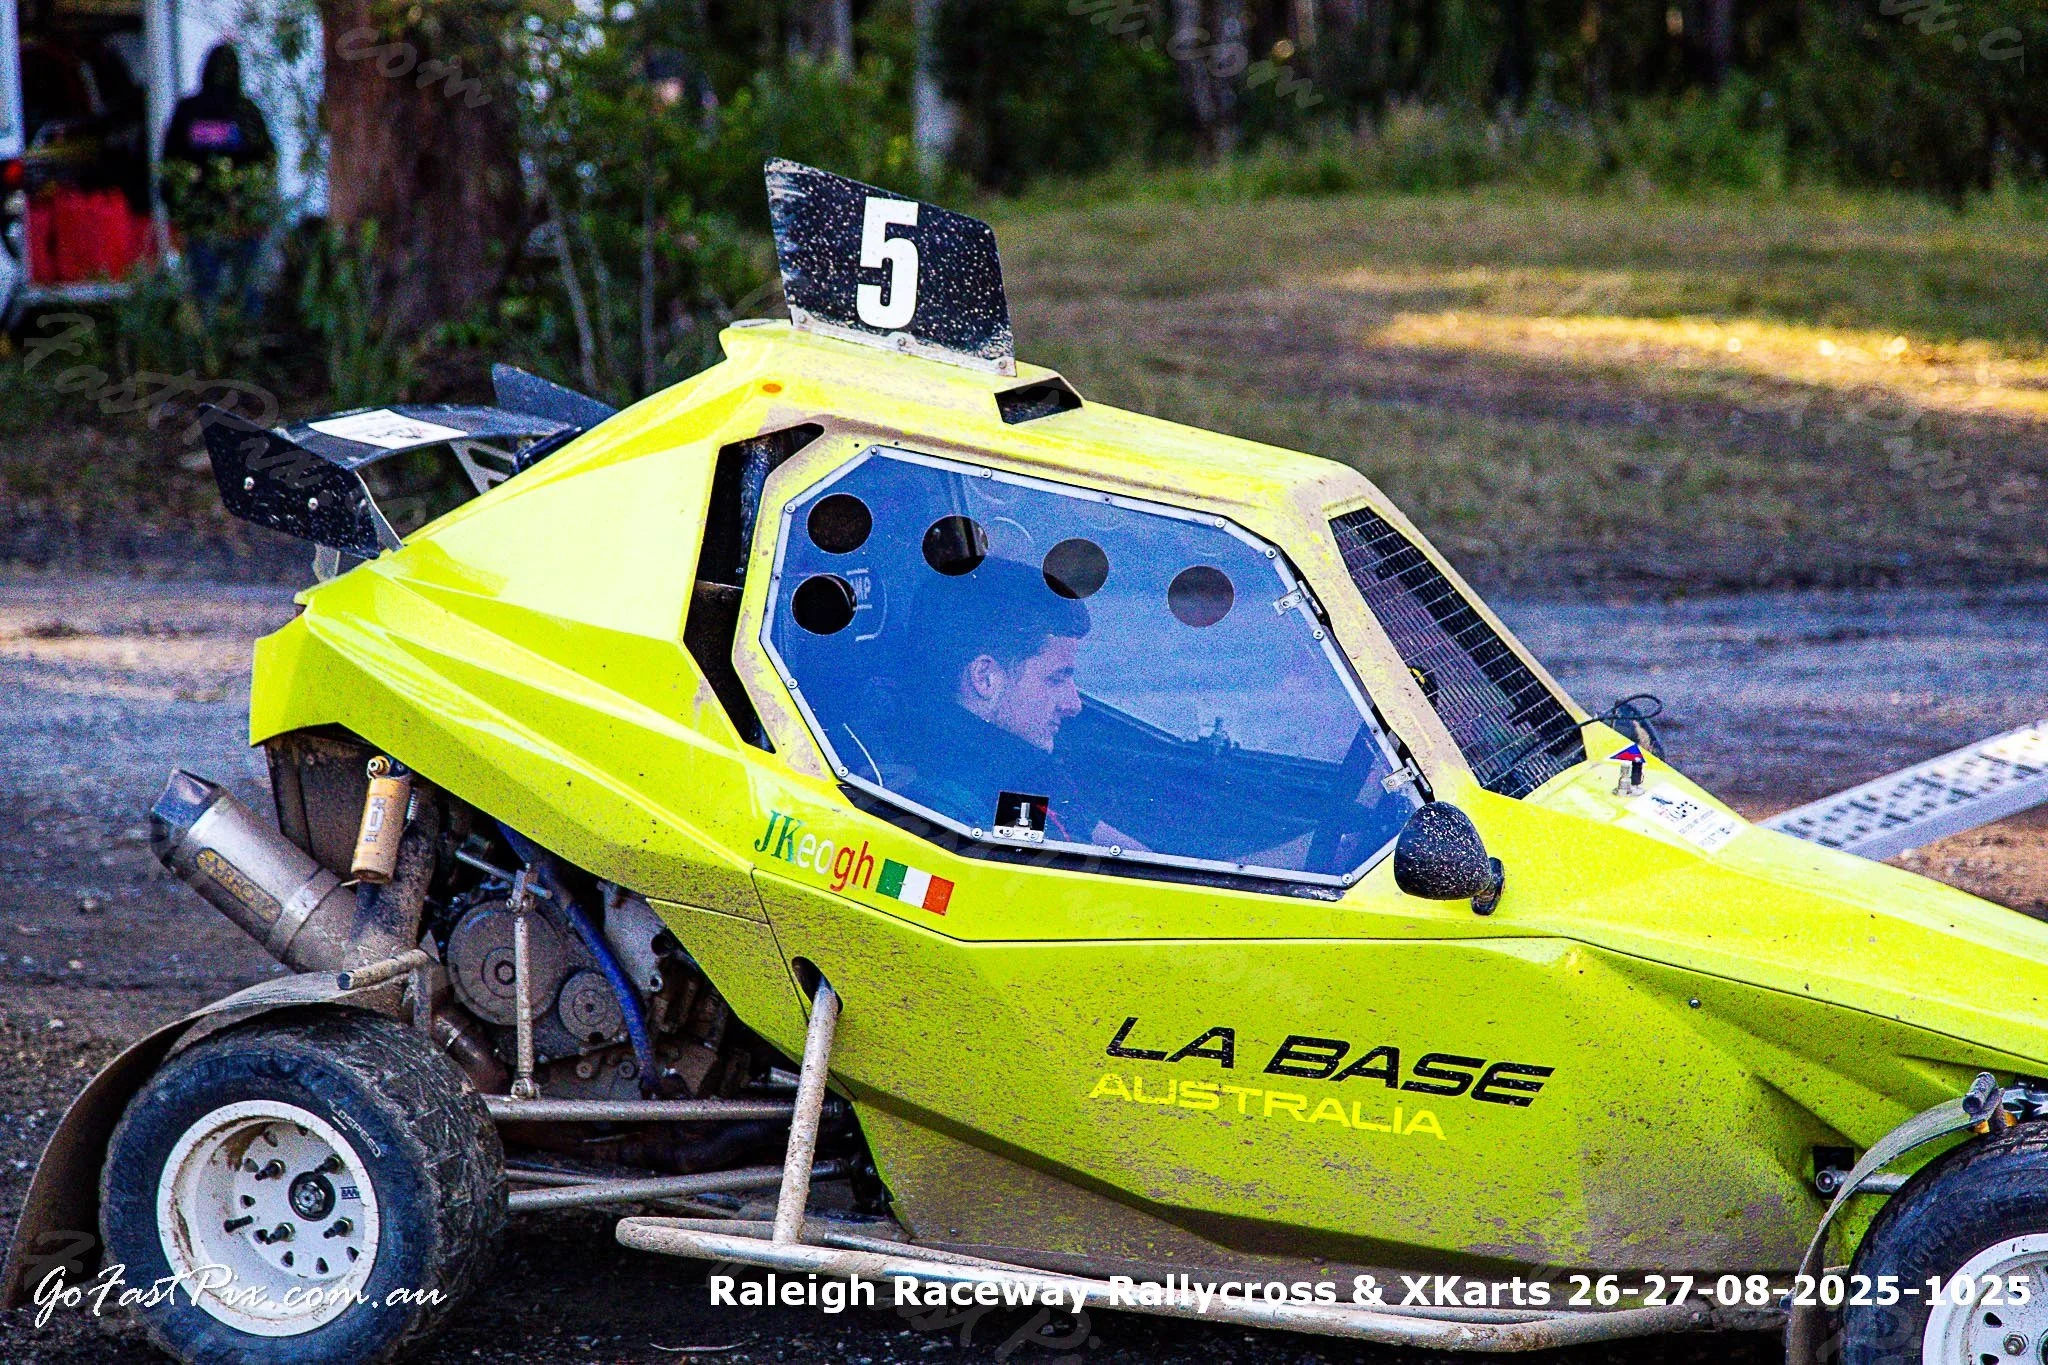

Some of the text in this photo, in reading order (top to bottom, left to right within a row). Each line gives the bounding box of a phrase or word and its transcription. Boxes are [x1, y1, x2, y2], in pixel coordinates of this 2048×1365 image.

[856, 197, 919, 329] 5
[754, 809, 875, 892] JKeogh
[1105, 1016, 1556, 1108] LA BASE
[1089, 1073, 1447, 1141] AUSTRALIA
